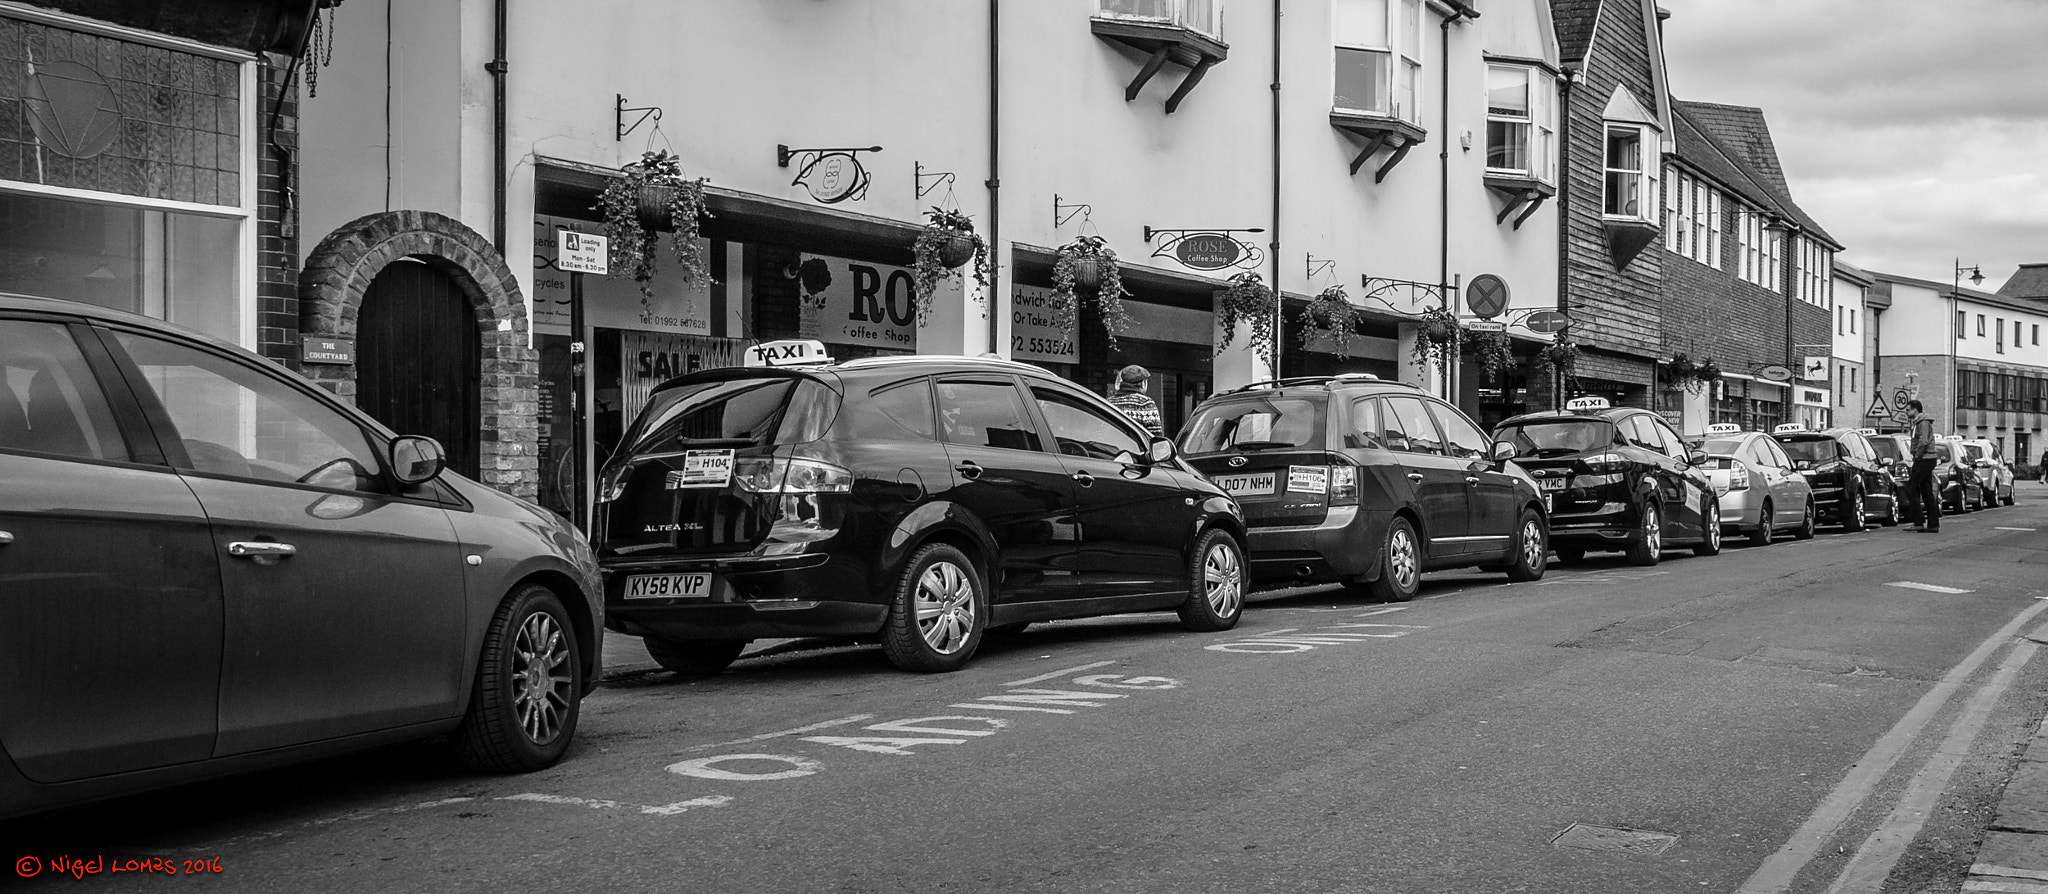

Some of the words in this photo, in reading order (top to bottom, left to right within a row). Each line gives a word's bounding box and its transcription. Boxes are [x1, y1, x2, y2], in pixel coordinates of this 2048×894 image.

[581, 237, 600, 247] Loading
[1188, 240, 1228, 253] ROSE
[1187, 254, 1209, 262] Coffee
[1210, 255, 1228, 264] Shop
[535, 278, 565, 290] cycles
[655, 316, 678, 327] 01992
[1013, 311, 1026, 324] Or
[1027, 313, 1048, 327] Take
[843, 325, 878, 340] offee
[885, 329, 911, 345] Shop
[322, 342, 335, 350] THE
[1029, 337, 1074, 356] 553524
[309, 351, 348, 361] COURTYARD
[753, 344, 804, 361] TAXI
[1573, 399, 1601, 408] TAXI
[1896, 395, 1906, 405] 30
[702, 458, 727, 468] H104
[1250, 476, 1273, 490] NHM
[1303, 473, 1323, 483] H106
[1545, 478, 1563, 489] VMC
[643, 523, 681, 532] ALTEA
[631, 577, 669, 597] KY58
[672, 575, 704, 595] KVP
